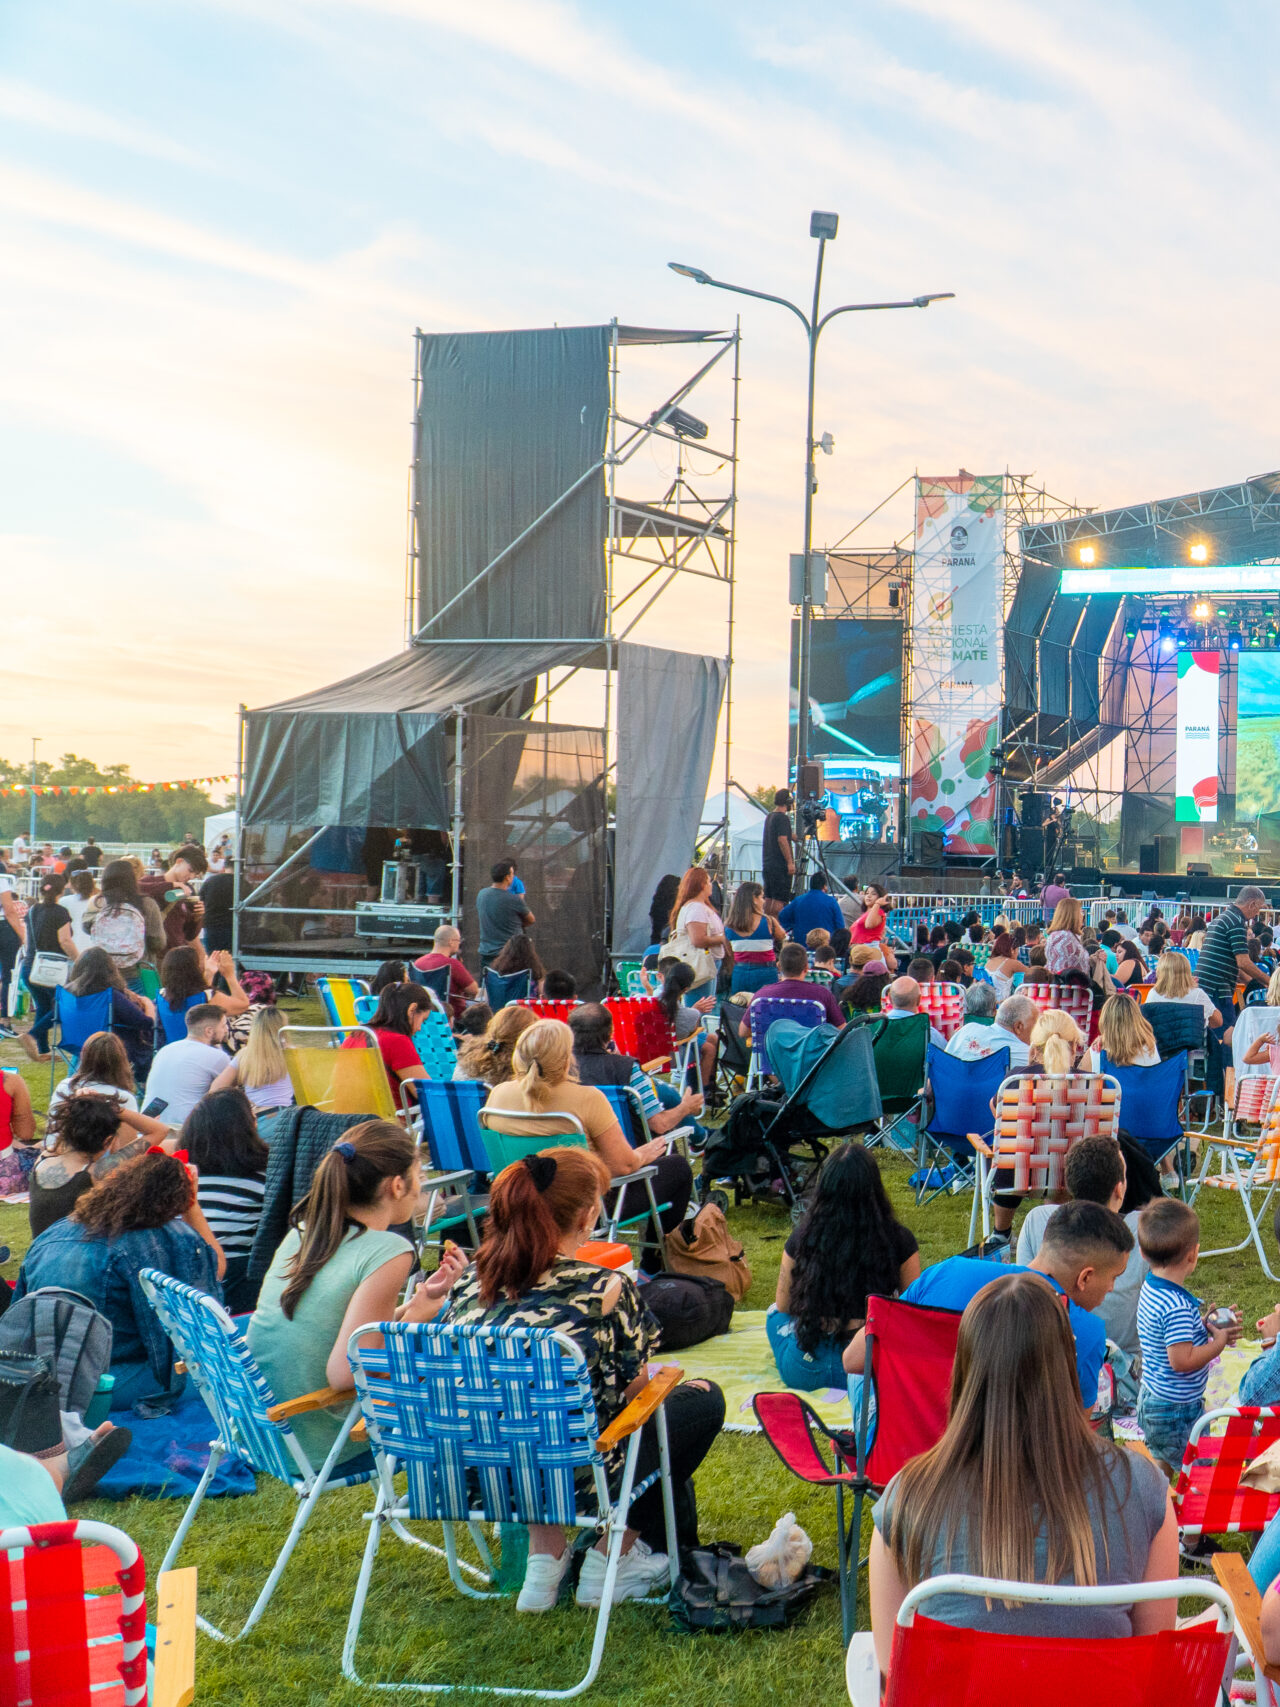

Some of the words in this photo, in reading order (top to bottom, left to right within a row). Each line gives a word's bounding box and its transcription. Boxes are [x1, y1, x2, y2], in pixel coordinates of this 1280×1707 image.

[942, 557, 976, 567] PARANÁ
[952, 650, 988, 661] MATE
[940, 680, 973, 689] PARANÁ
